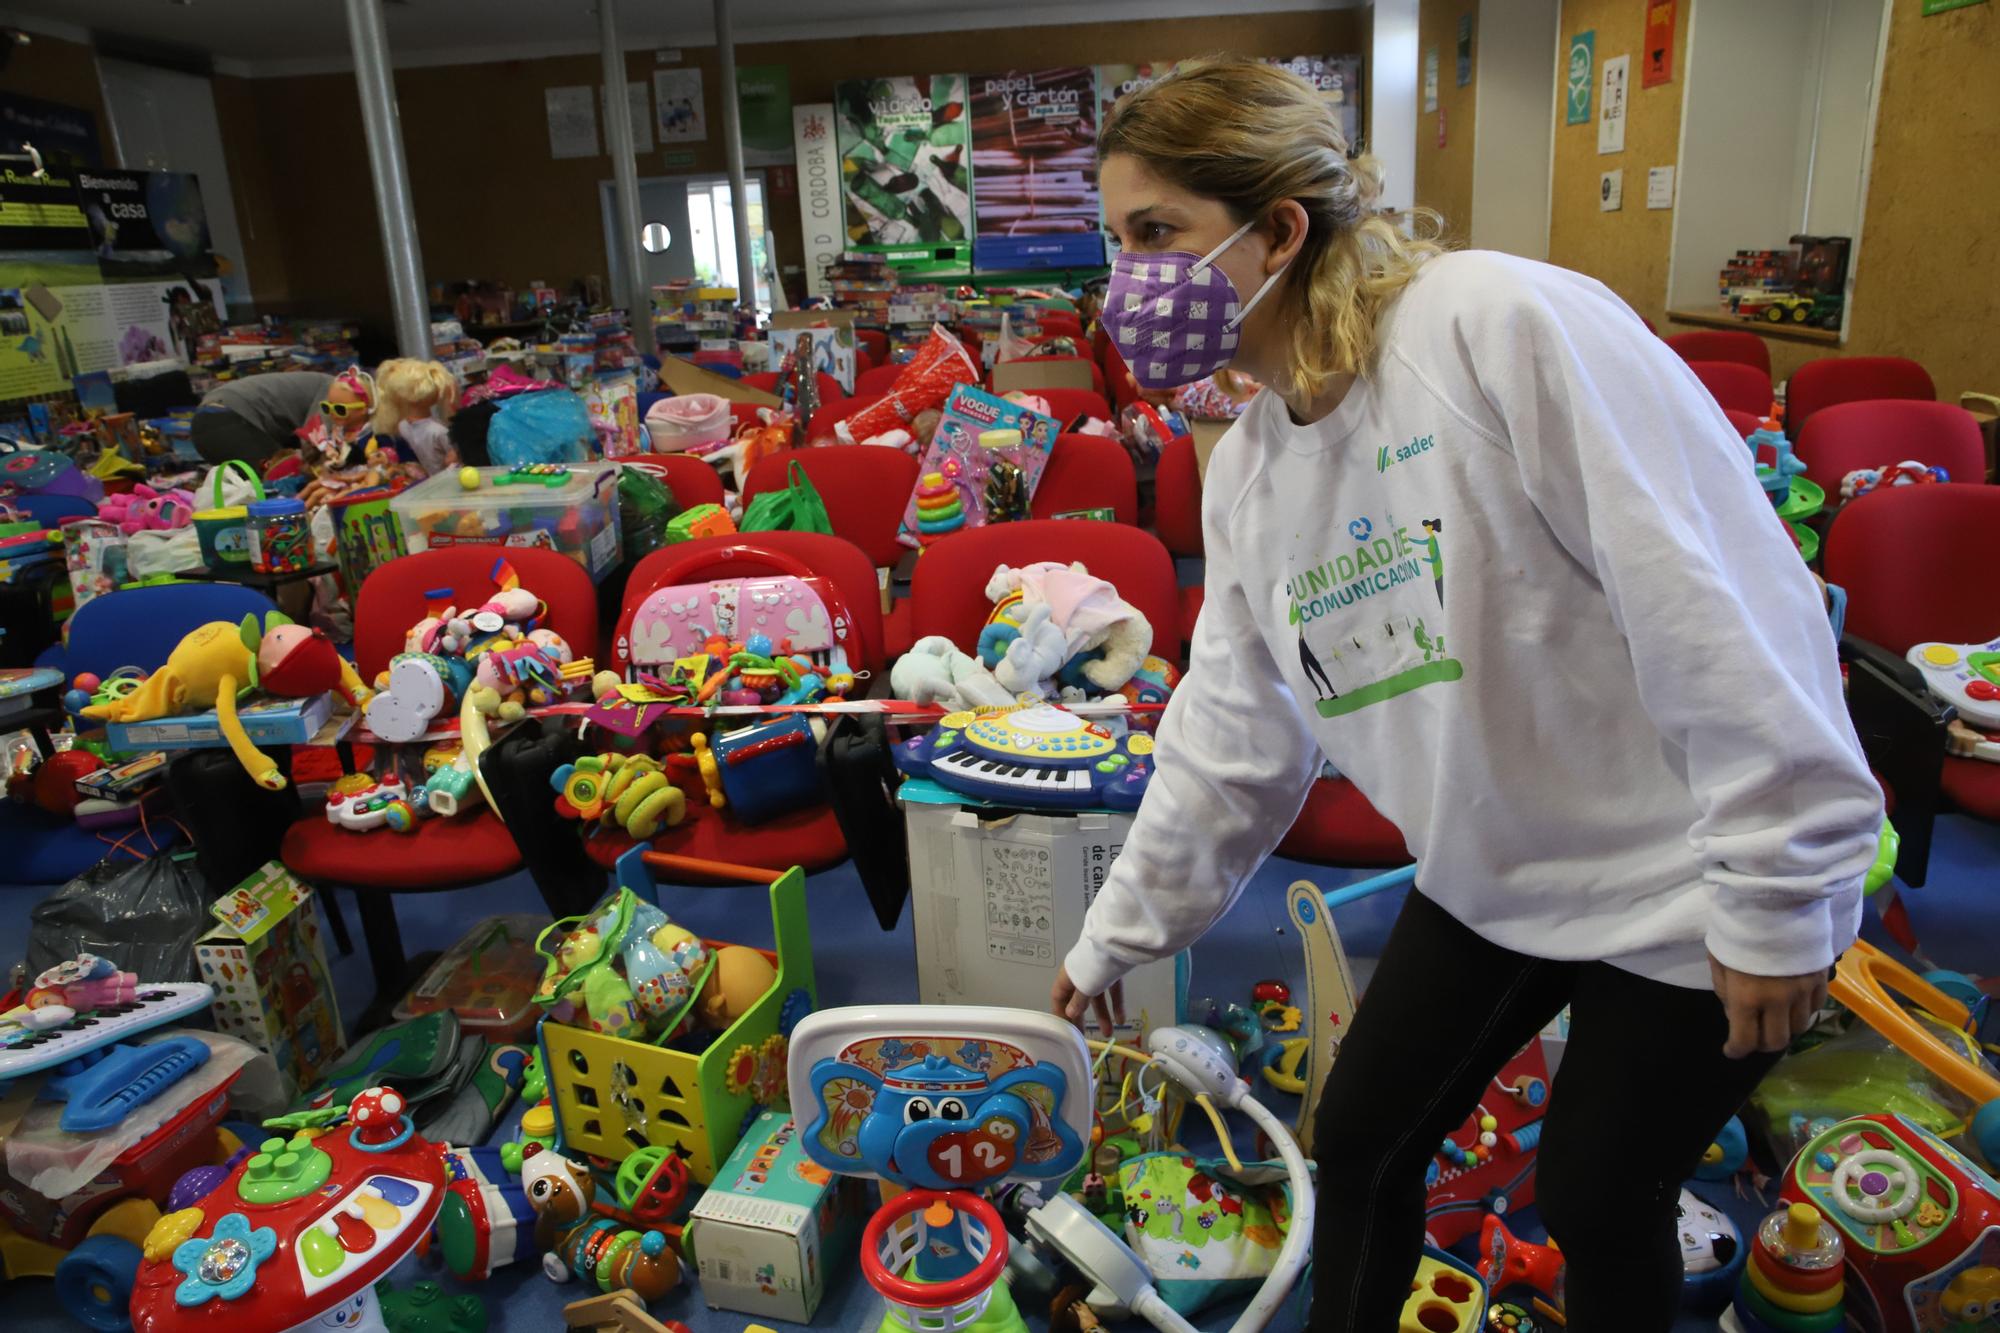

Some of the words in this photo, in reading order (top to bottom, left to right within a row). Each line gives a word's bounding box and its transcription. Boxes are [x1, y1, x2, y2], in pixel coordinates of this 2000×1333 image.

[1315, 60, 1324, 73] e
[985, 74, 1035, 97] papel
[868, 93, 932, 113] vidrio
[1002, 92, 1014, 111] y
[1017, 86, 1079, 106] cartón
[80, 174, 139, 191] Bienvenido
[808, 146, 830, 218] CORDOBA
[111, 203, 147, 219] casa
[959, 394, 1001, 420] VOGUE
[1396, 434, 1434, 462] sadec
[1291, 537, 1393, 601] UNIDAD
[1092, 845, 1106, 861] de
[988, 1121, 1016, 1139] 3
[938, 1144, 962, 1178] 1
[973, 1141, 1006, 1168] 2
